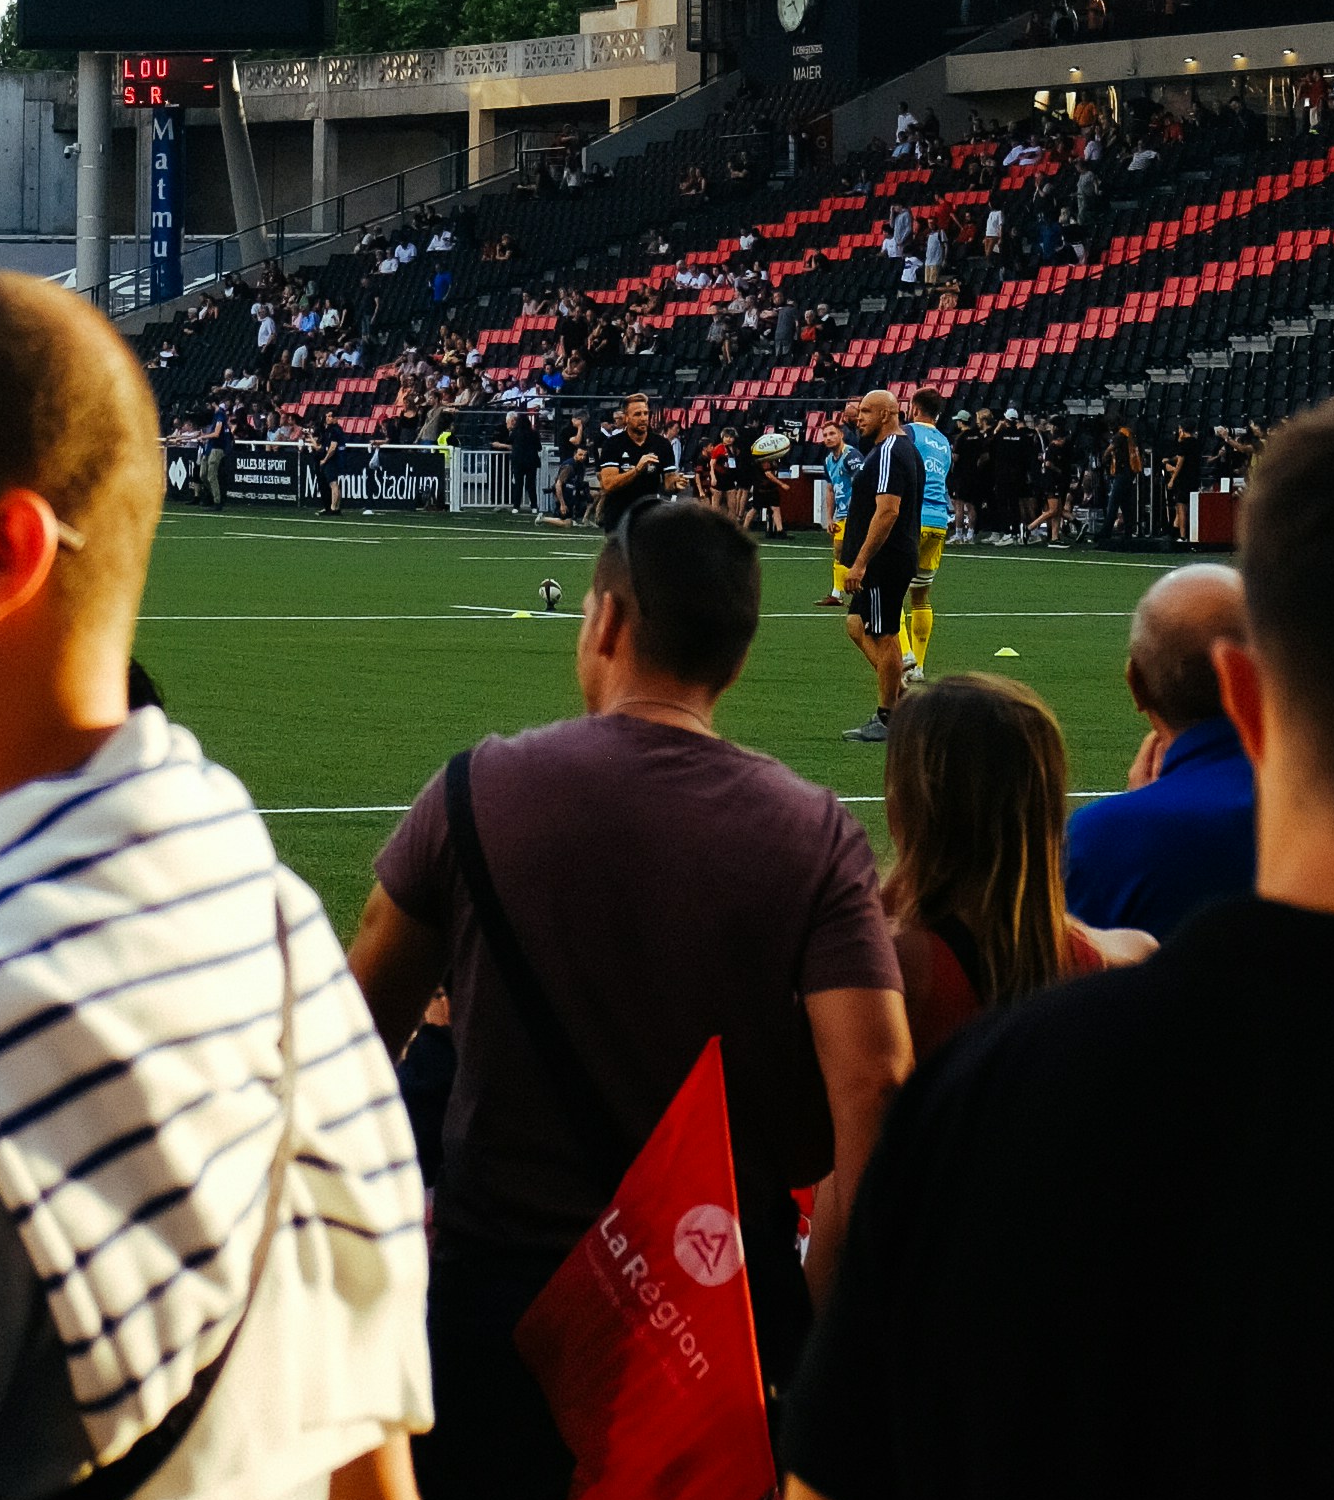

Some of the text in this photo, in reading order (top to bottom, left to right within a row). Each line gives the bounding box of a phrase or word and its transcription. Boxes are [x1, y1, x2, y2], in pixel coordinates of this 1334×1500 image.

[124, 59, 167, 78] LOU
[793, 65, 822, 81] MAIER
[305, 464, 369, 499] Mmut
[600, 1209, 628, 1258] La
[621, 1253, 710, 1380] Région
